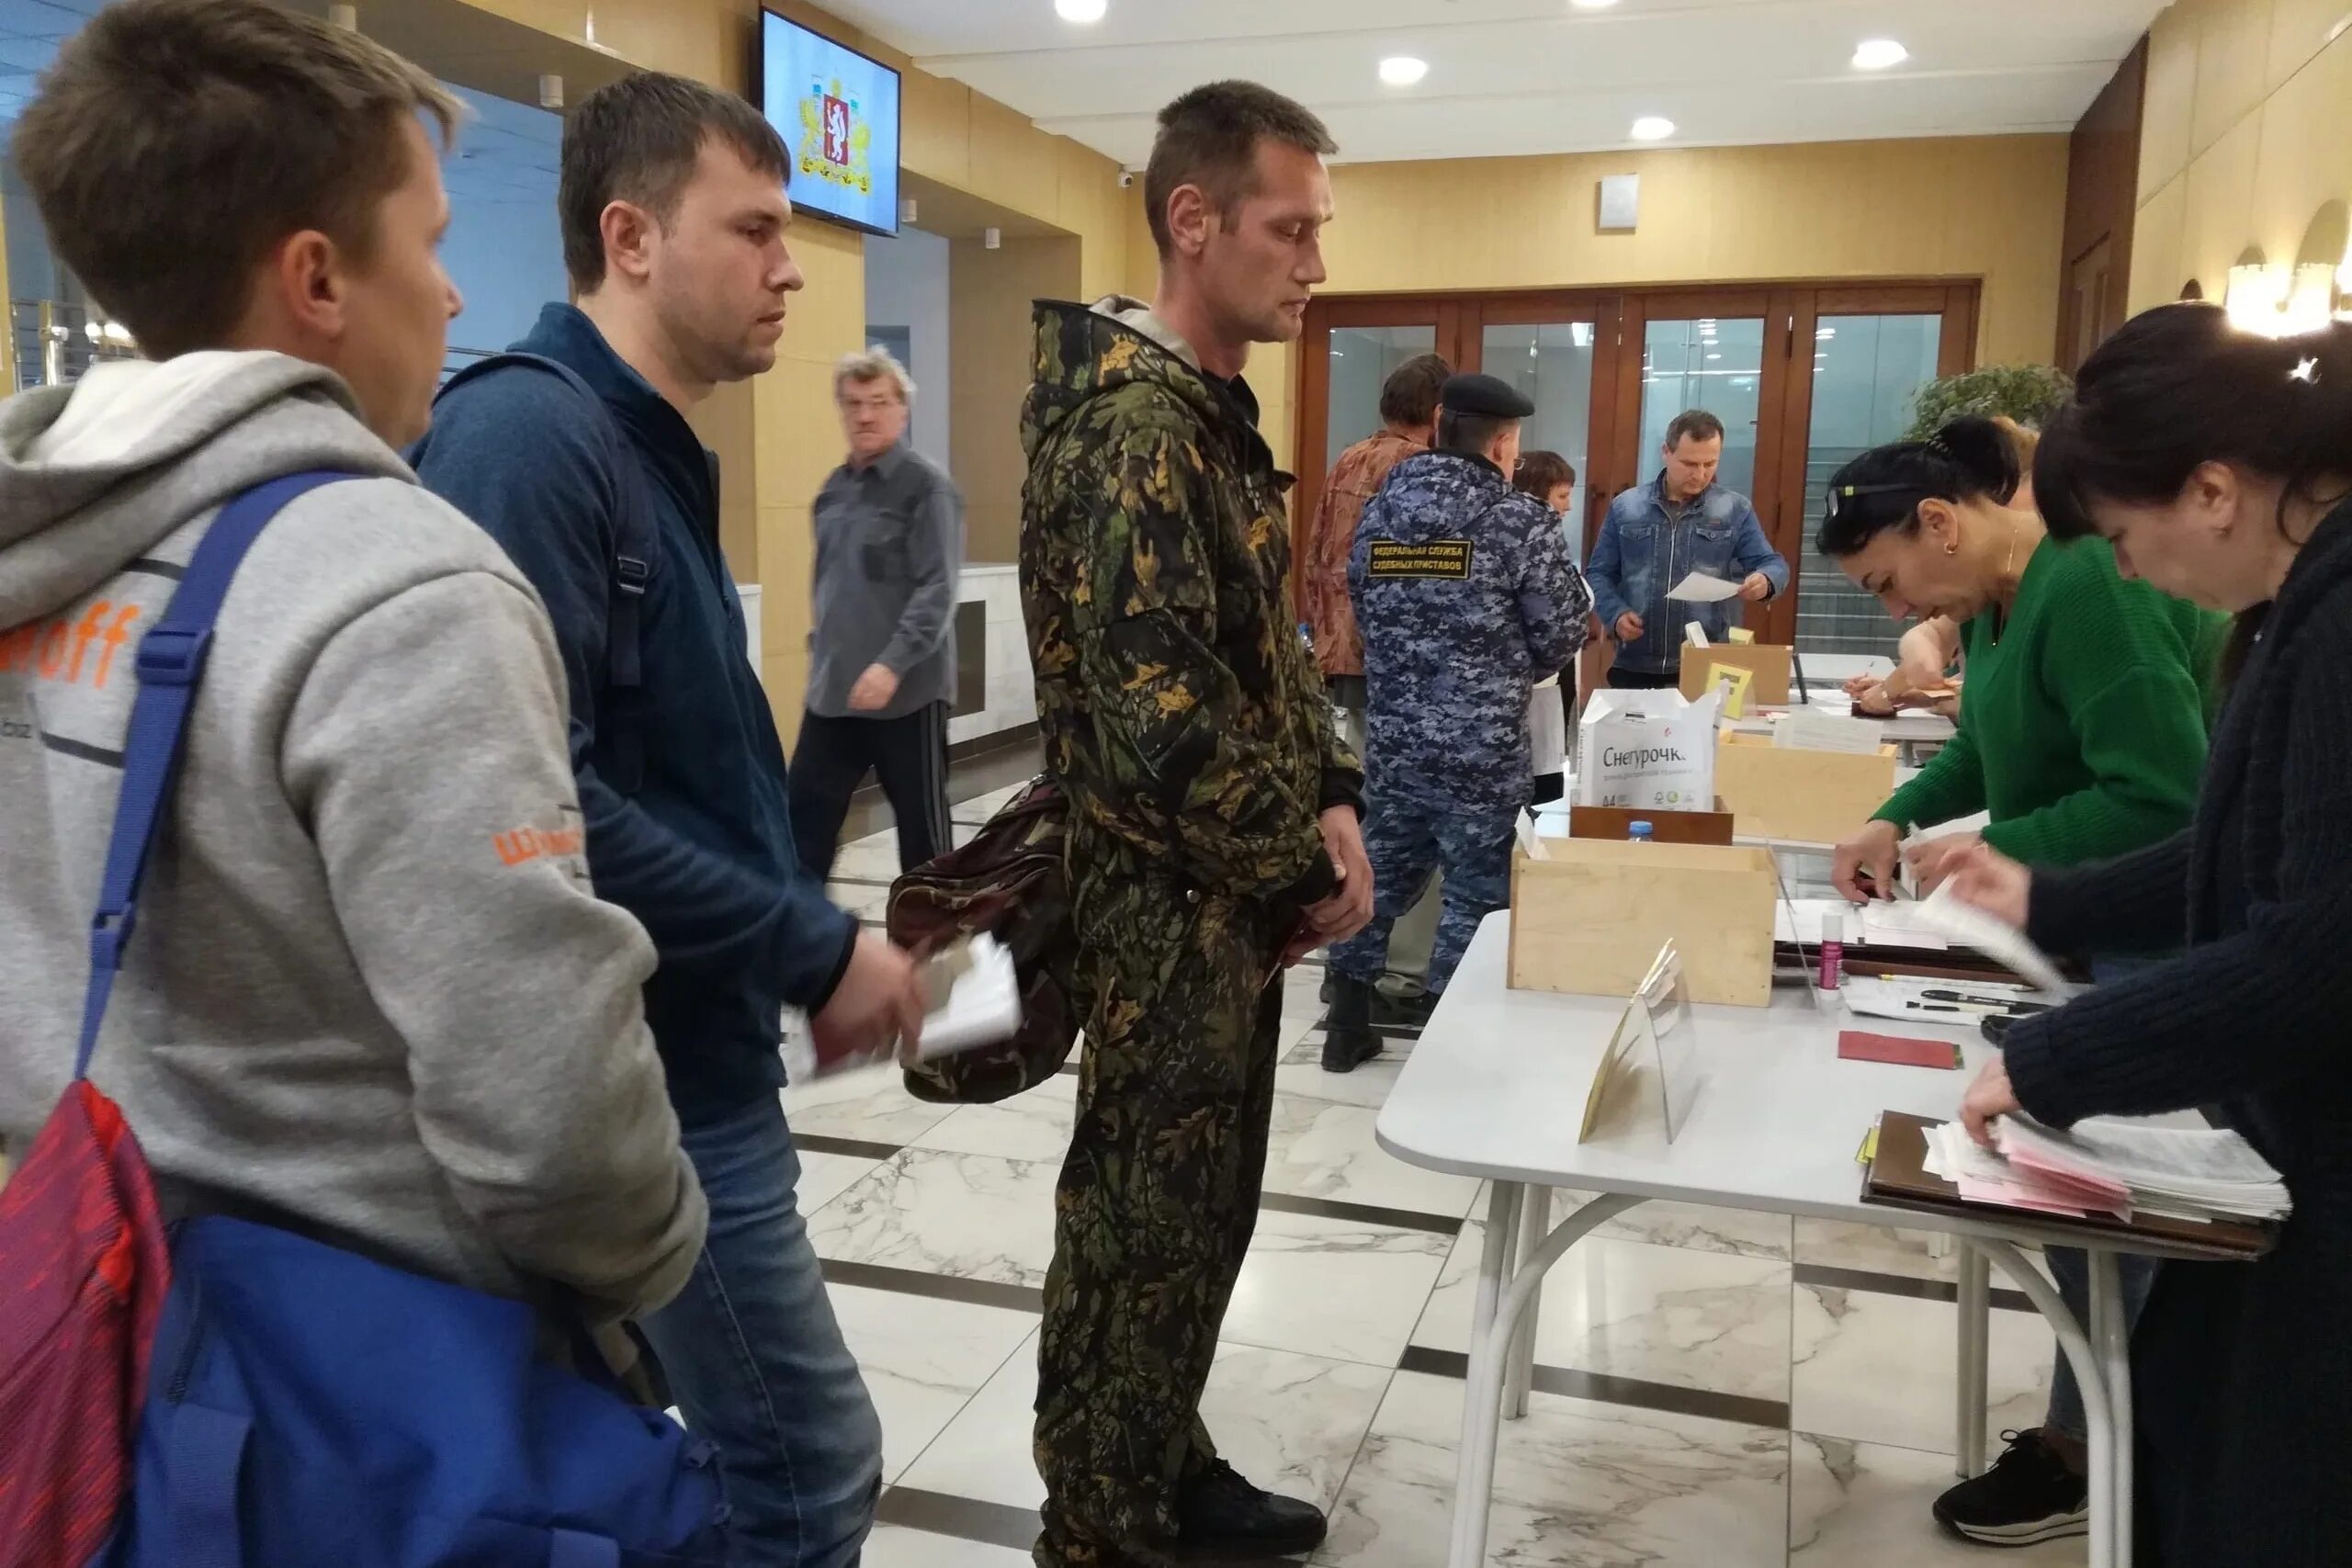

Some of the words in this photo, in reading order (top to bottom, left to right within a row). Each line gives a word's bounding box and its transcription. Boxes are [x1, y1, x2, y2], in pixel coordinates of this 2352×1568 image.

[1428, 547, 1464, 557] СЛУЖБА
[1373, 560, 1413, 571] СУДЕБНЫХ
[1414, 561, 1462, 570] ПРИСТАВОВ
[1603, 748, 1686, 769] Снегурочк
